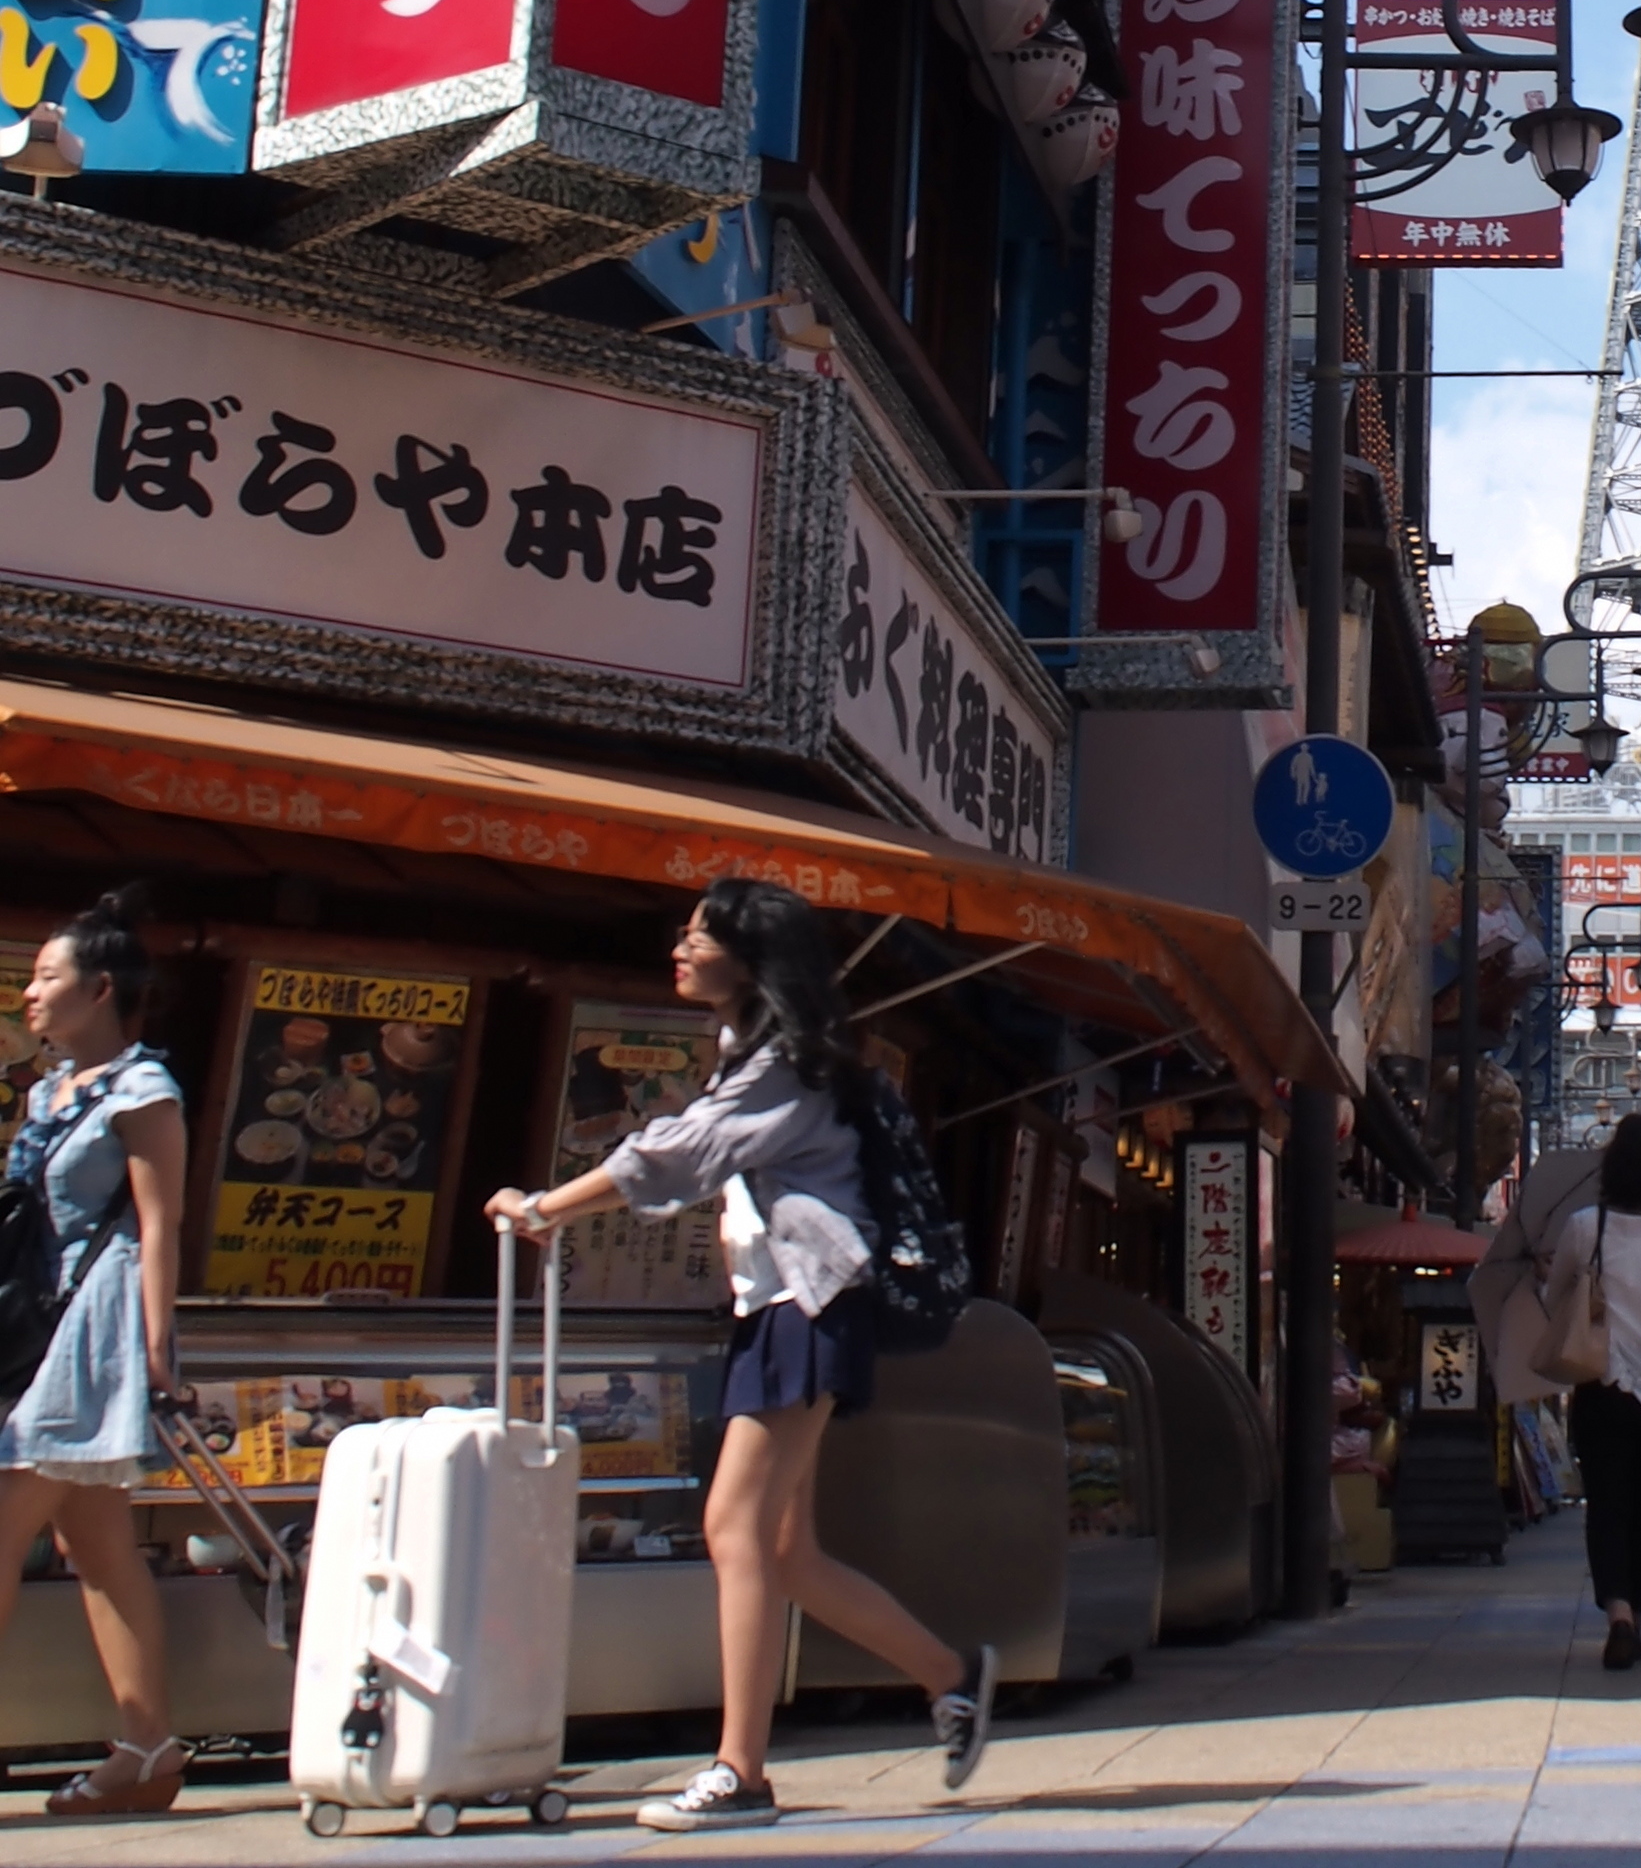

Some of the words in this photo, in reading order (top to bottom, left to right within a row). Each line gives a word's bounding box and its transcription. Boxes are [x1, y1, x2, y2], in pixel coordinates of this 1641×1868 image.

[1402, 221, 1512, 248] 年中無休
[0, 367, 723, 608] づぼらや本店
[1279, 894, 1362, 921] 9-22
